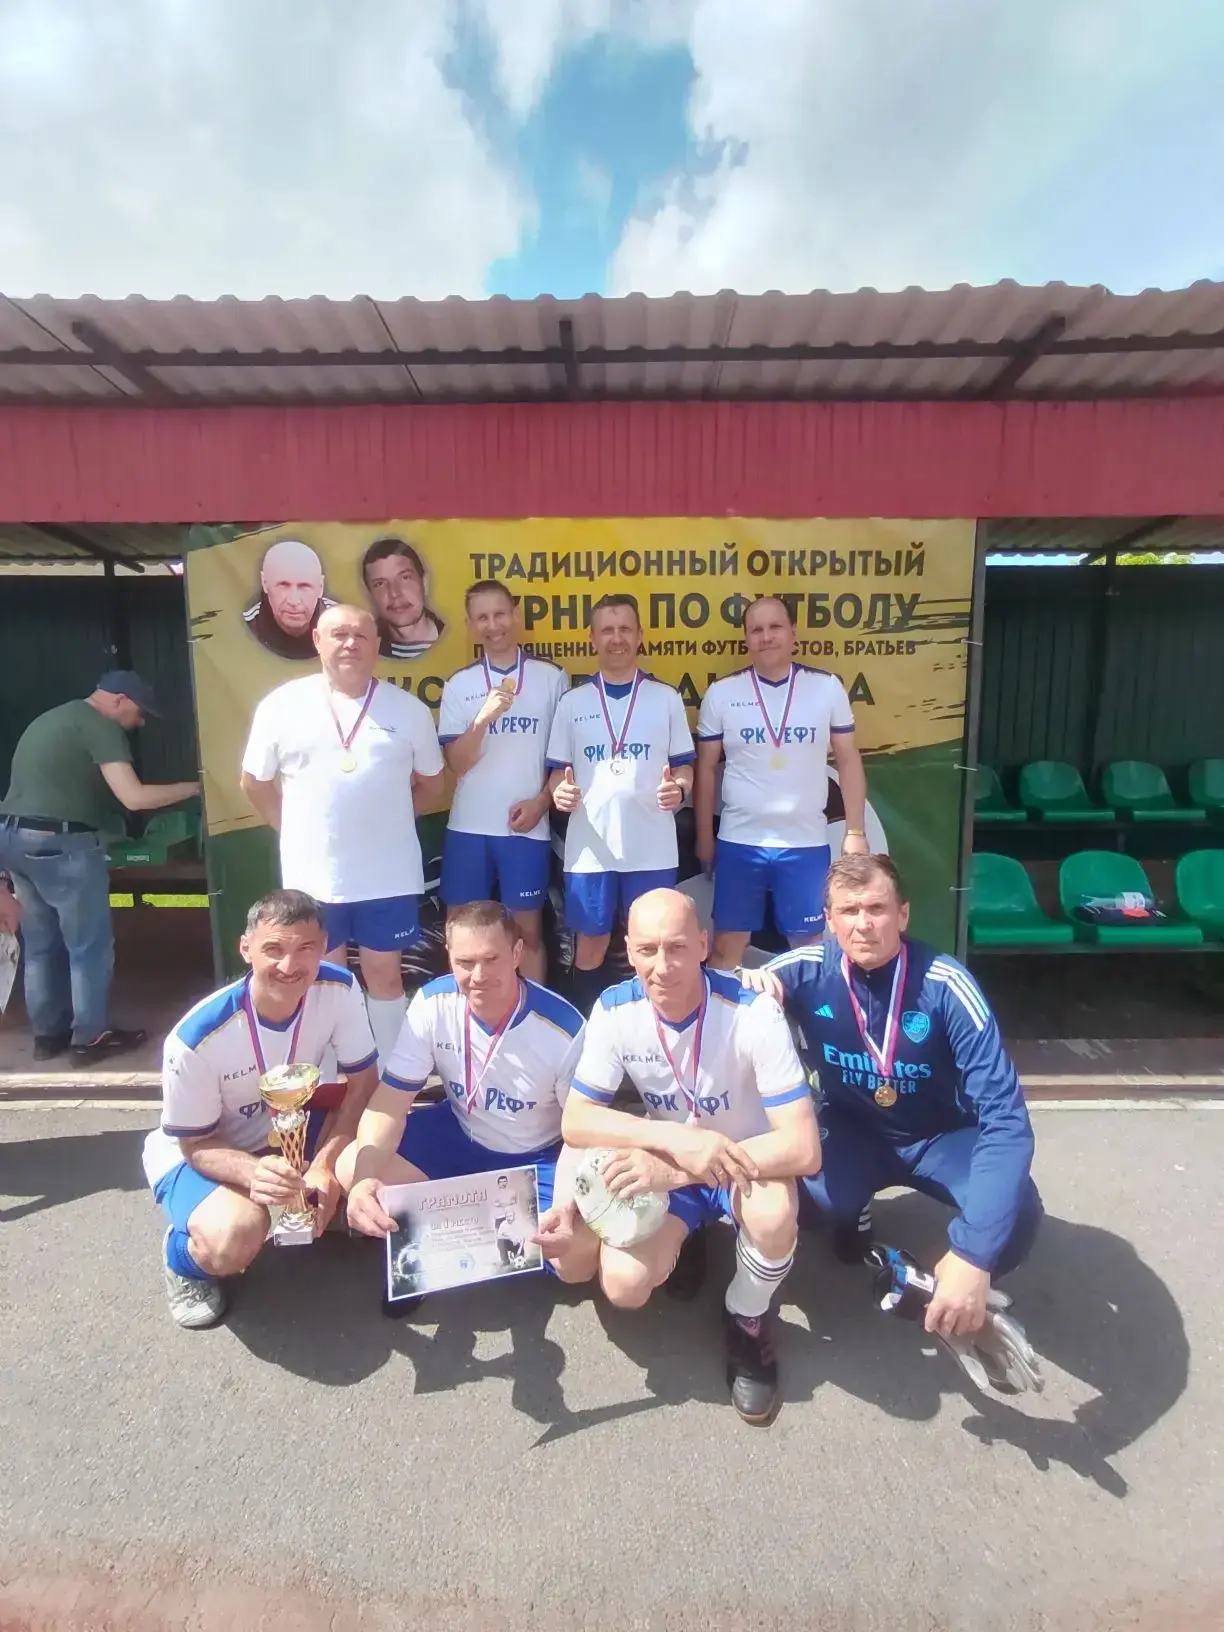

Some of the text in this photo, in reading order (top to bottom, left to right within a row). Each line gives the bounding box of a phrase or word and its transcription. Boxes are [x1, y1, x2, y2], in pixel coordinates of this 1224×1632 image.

[469, 541, 926, 583] ТРАДИЦИОННЫЙ ОТКРЫТЫЙ
[649, 592, 710, 630] ПО
[635, 639, 698, 657] АМЯТИ
[844, 639, 917, 656] БРАТЬЕВ
[501, 716, 540, 735] РЕФТ
[740, 727, 766, 744] ФК
[583, 743, 606, 763] ФК
[842, 1069, 863, 1086] FLY
[485, 1087, 537, 1113] РЕФТ
[643, 1091, 680, 1112] ФК
